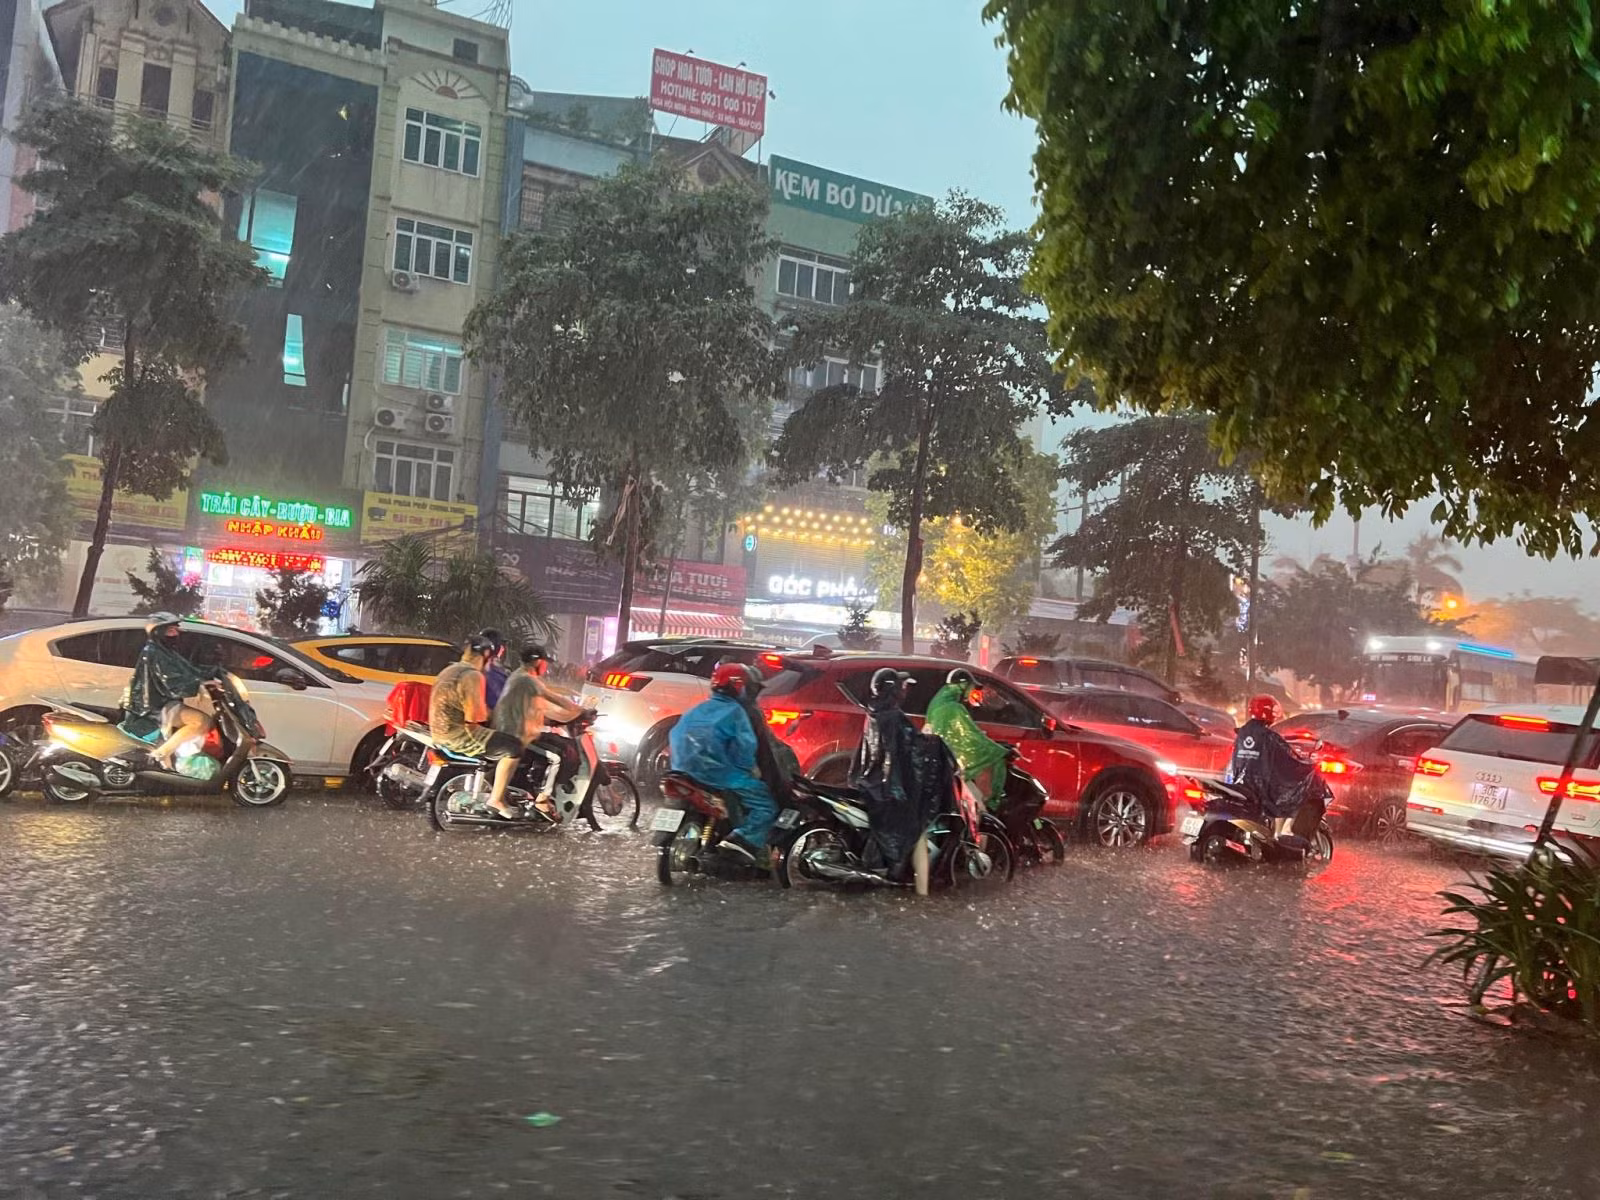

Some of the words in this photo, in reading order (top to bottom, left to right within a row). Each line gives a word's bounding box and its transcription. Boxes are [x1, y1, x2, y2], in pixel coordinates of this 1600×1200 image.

[655, 55, 676, 77] SHOP
[701, 91, 720, 108] 0931
[723, 96, 739, 112] 000
[742, 100, 758, 116] 117
[775, 168, 820, 200] KEM
[825, 181, 856, 210] BƠ
[201, 491, 237, 514] TRÁI
[240, 495, 271, 518] CÂY
[325, 508, 350, 527] BIA
[227, 520, 274, 537] NHẬP
[769, 573, 813, 596] GÓC
